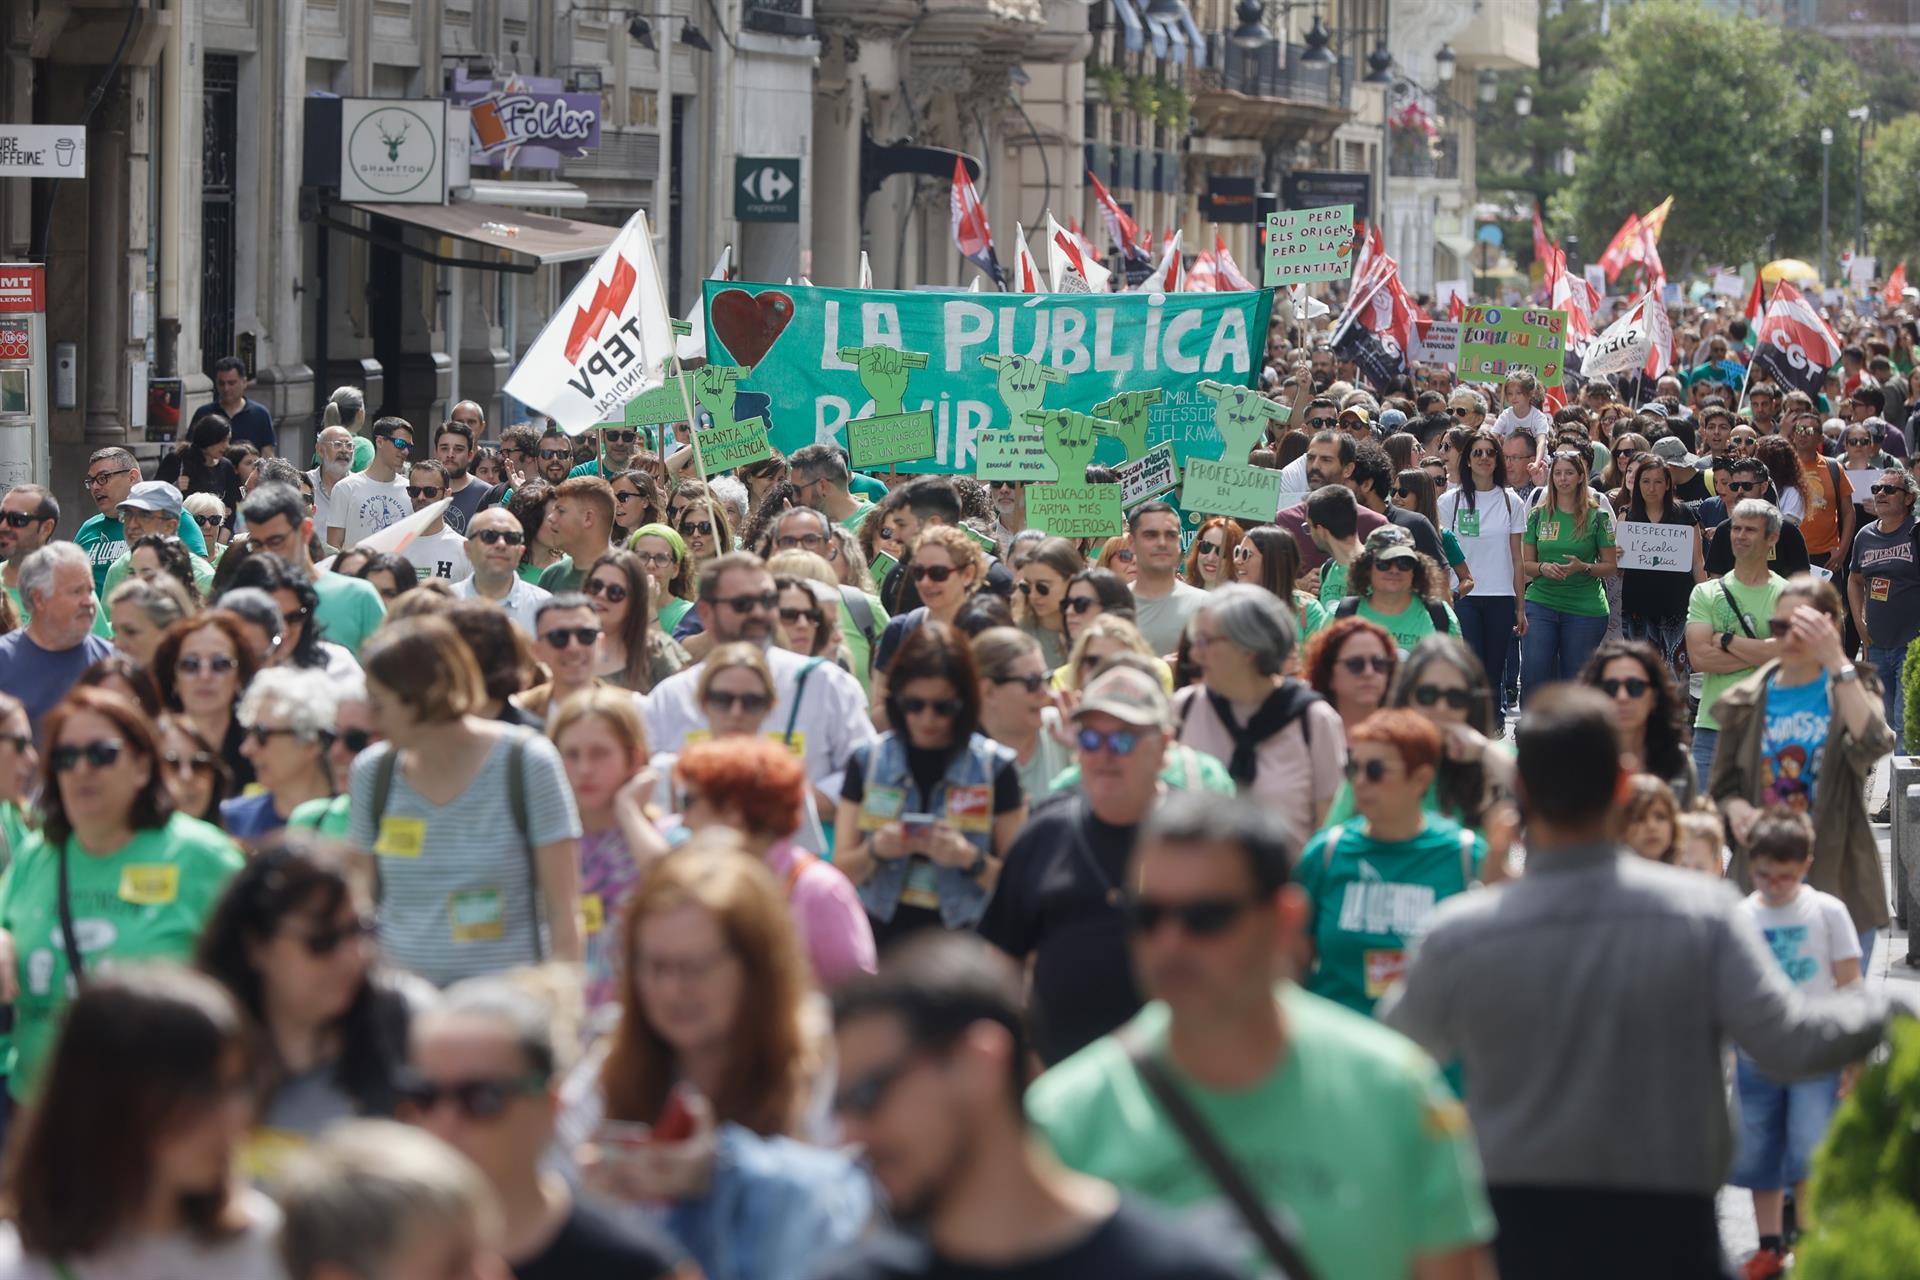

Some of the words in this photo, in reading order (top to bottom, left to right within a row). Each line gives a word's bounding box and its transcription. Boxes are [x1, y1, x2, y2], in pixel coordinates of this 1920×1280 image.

[494, 98, 591, 137] Folder
[1270, 217, 1294, 227] QUI
[1309, 211, 1341, 222] PERD
[1272, 232, 1293, 242] ELS
[1301, 224, 1353, 237] ORIGENS
[1273, 244, 1307, 256] PERD
[1320, 242, 1334, 251] LA
[1277, 261, 1349, 275] IDENTITAT
[821, 300, 902, 371] LA
[1771, 329, 1823, 382] CGT
[982, 433, 994, 442] NO
[899, 442, 925, 454] DRET
[1190, 462, 1279, 491] PROFESSORAT
[1132, 485, 1143, 495] UN
[1217, 487, 1230, 496] EN
[1078, 502, 1101, 515] MÉS
[1048, 518, 1116, 533] PODEROSA
[1627, 525, 1687, 539] RESPECTEM
[436, 561, 452, 578] H
